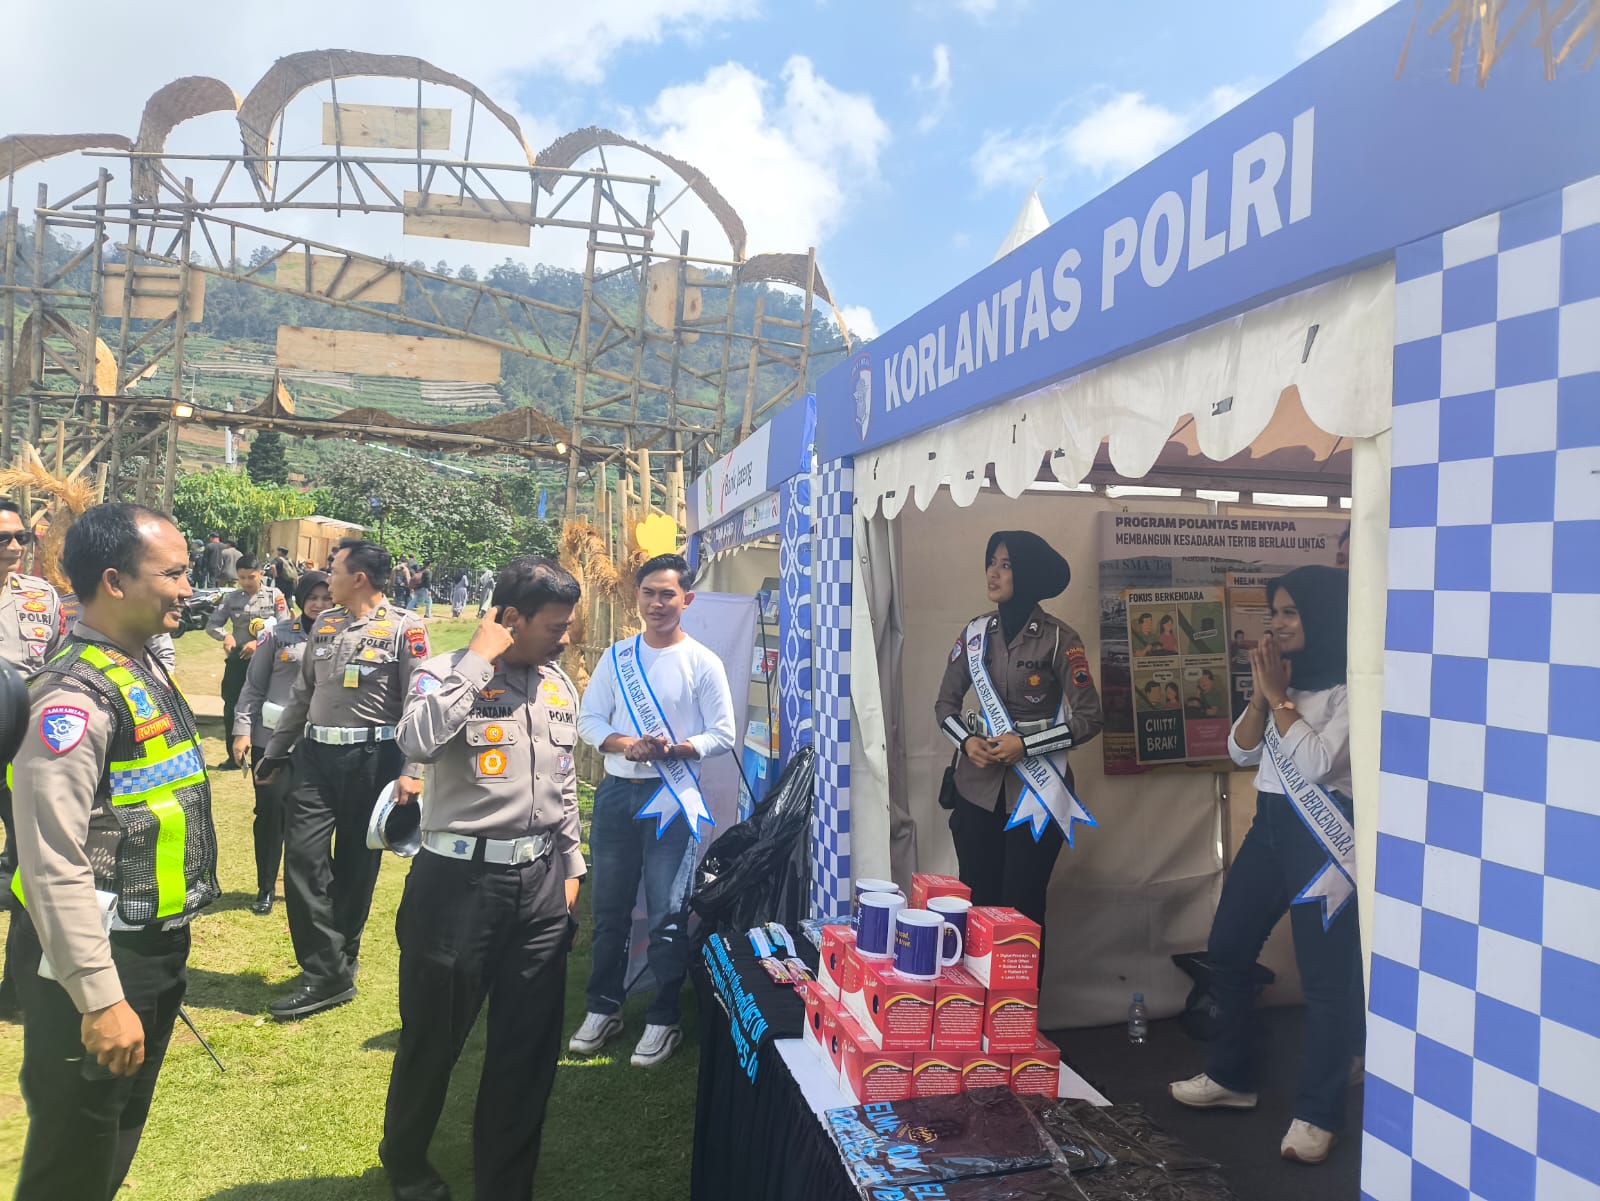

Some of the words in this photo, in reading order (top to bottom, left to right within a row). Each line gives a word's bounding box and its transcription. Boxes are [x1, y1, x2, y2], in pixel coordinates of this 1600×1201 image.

[885, 248, 1082, 413] KORLANTAS
[1101, 106, 1316, 312] POLRI
[1115, 516, 1177, 529] PROGRAM
[1178, 518, 1239, 530] POLANTAS
[1240, 520, 1297, 532] MENYAPA
[1115, 533, 1172, 546] MEMBANGUN
[1173, 534, 1226, 548] KESADARAN
[1227, 535, 1257, 548] TERTIB
[1258, 536, 1296, 549] BERLALU
[1297, 538, 1326, 550] LINTAS
[1233, 577, 1255, 586] HELM
[1128, 593, 1153, 603] FOKUS
[1154, 591, 1205, 602] BERKENDARA
[17, 611, 52, 625] POLRI
[360, 637, 392, 650] POLRI
[970, 653, 980, 678] DUTA
[468, 706, 513, 719] PRATAMA
[627, 680, 662, 734] KESELAMATAN
[549, 710, 574, 725] POLRI
[1146, 735, 1178, 752] BRAK!
[1300, 788, 1355, 857] BERKENDARA
